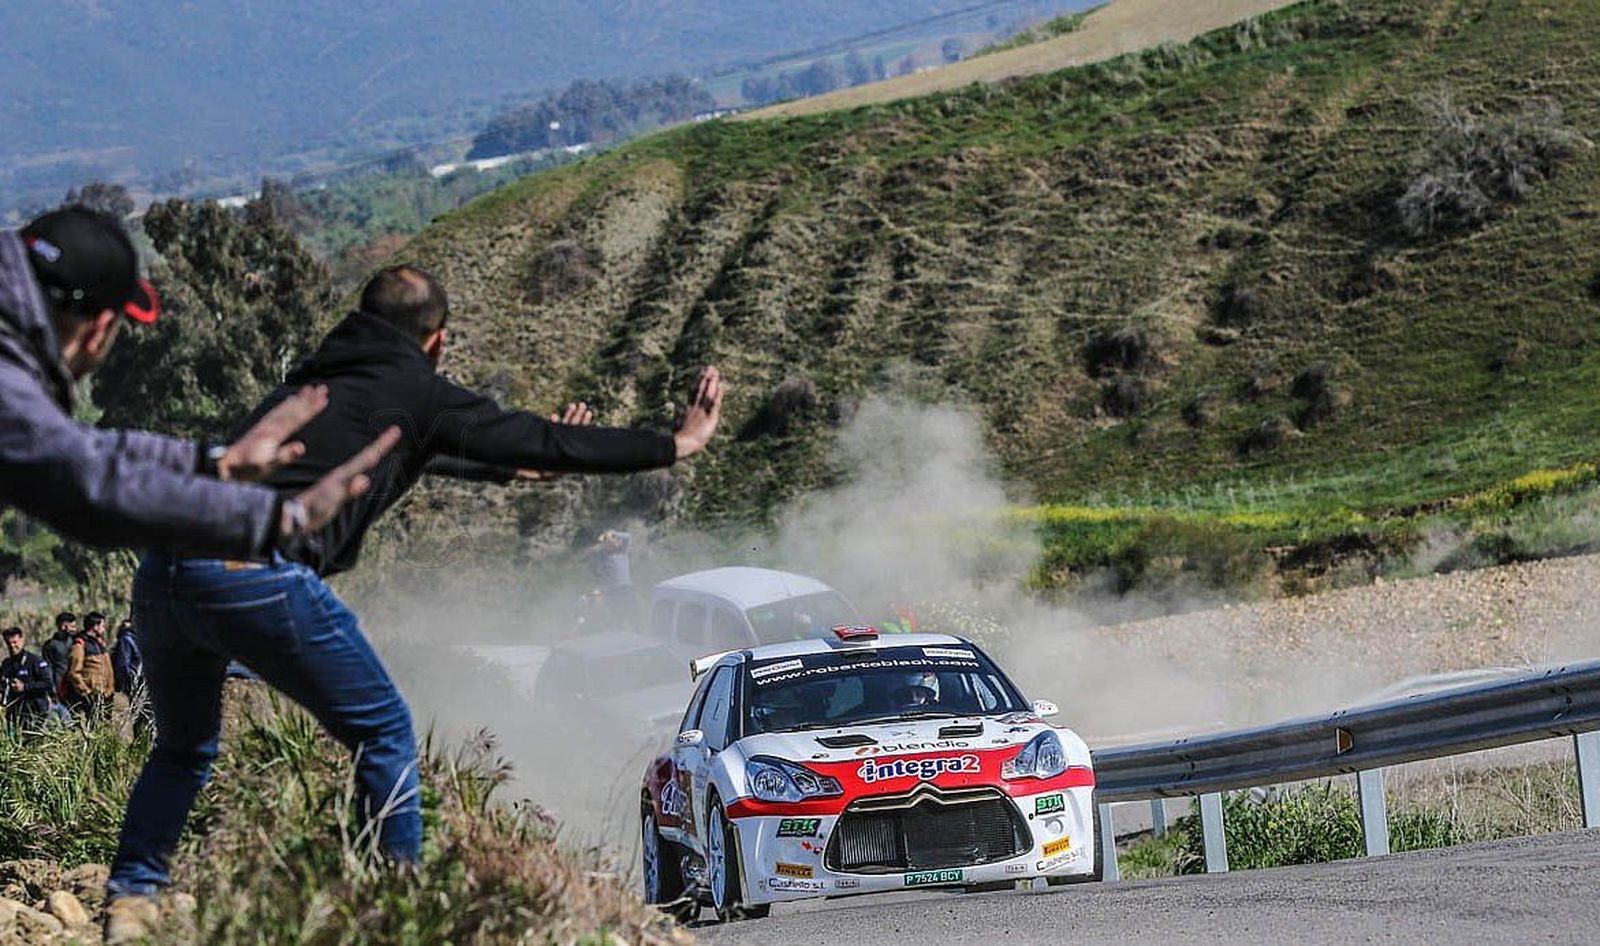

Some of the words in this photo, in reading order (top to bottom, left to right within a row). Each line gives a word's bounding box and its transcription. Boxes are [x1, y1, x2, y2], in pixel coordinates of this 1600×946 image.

[881, 740, 970, 753] blendio
[857, 754, 981, 783] integra2
[906, 876, 913, 885] P
[915, 872, 938, 884] 7524
[940, 870, 961, 881] BCY
